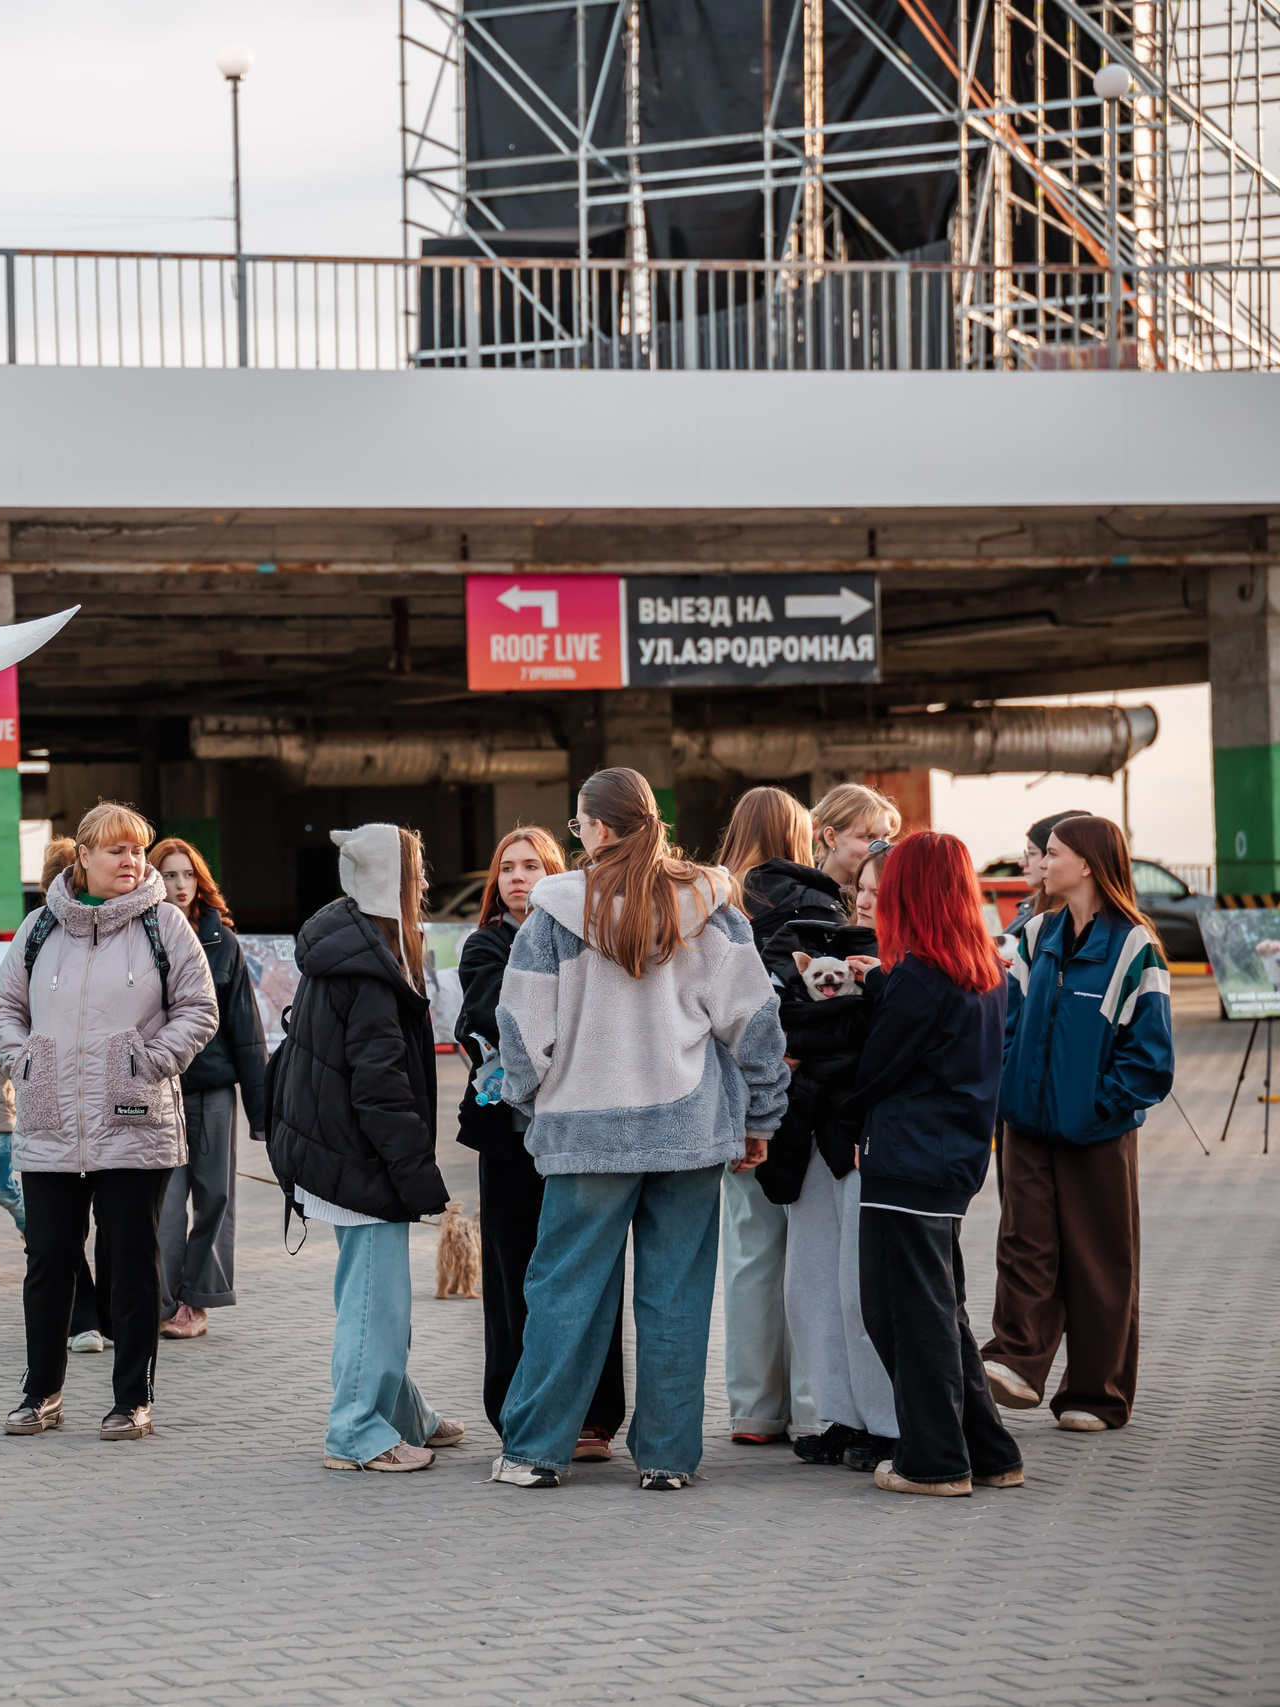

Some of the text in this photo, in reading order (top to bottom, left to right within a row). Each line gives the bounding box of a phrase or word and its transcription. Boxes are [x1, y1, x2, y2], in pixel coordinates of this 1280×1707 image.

[638, 595, 774, 628] ВЫЕЗД НА
[490, 632, 602, 663] ROOF LIVE
